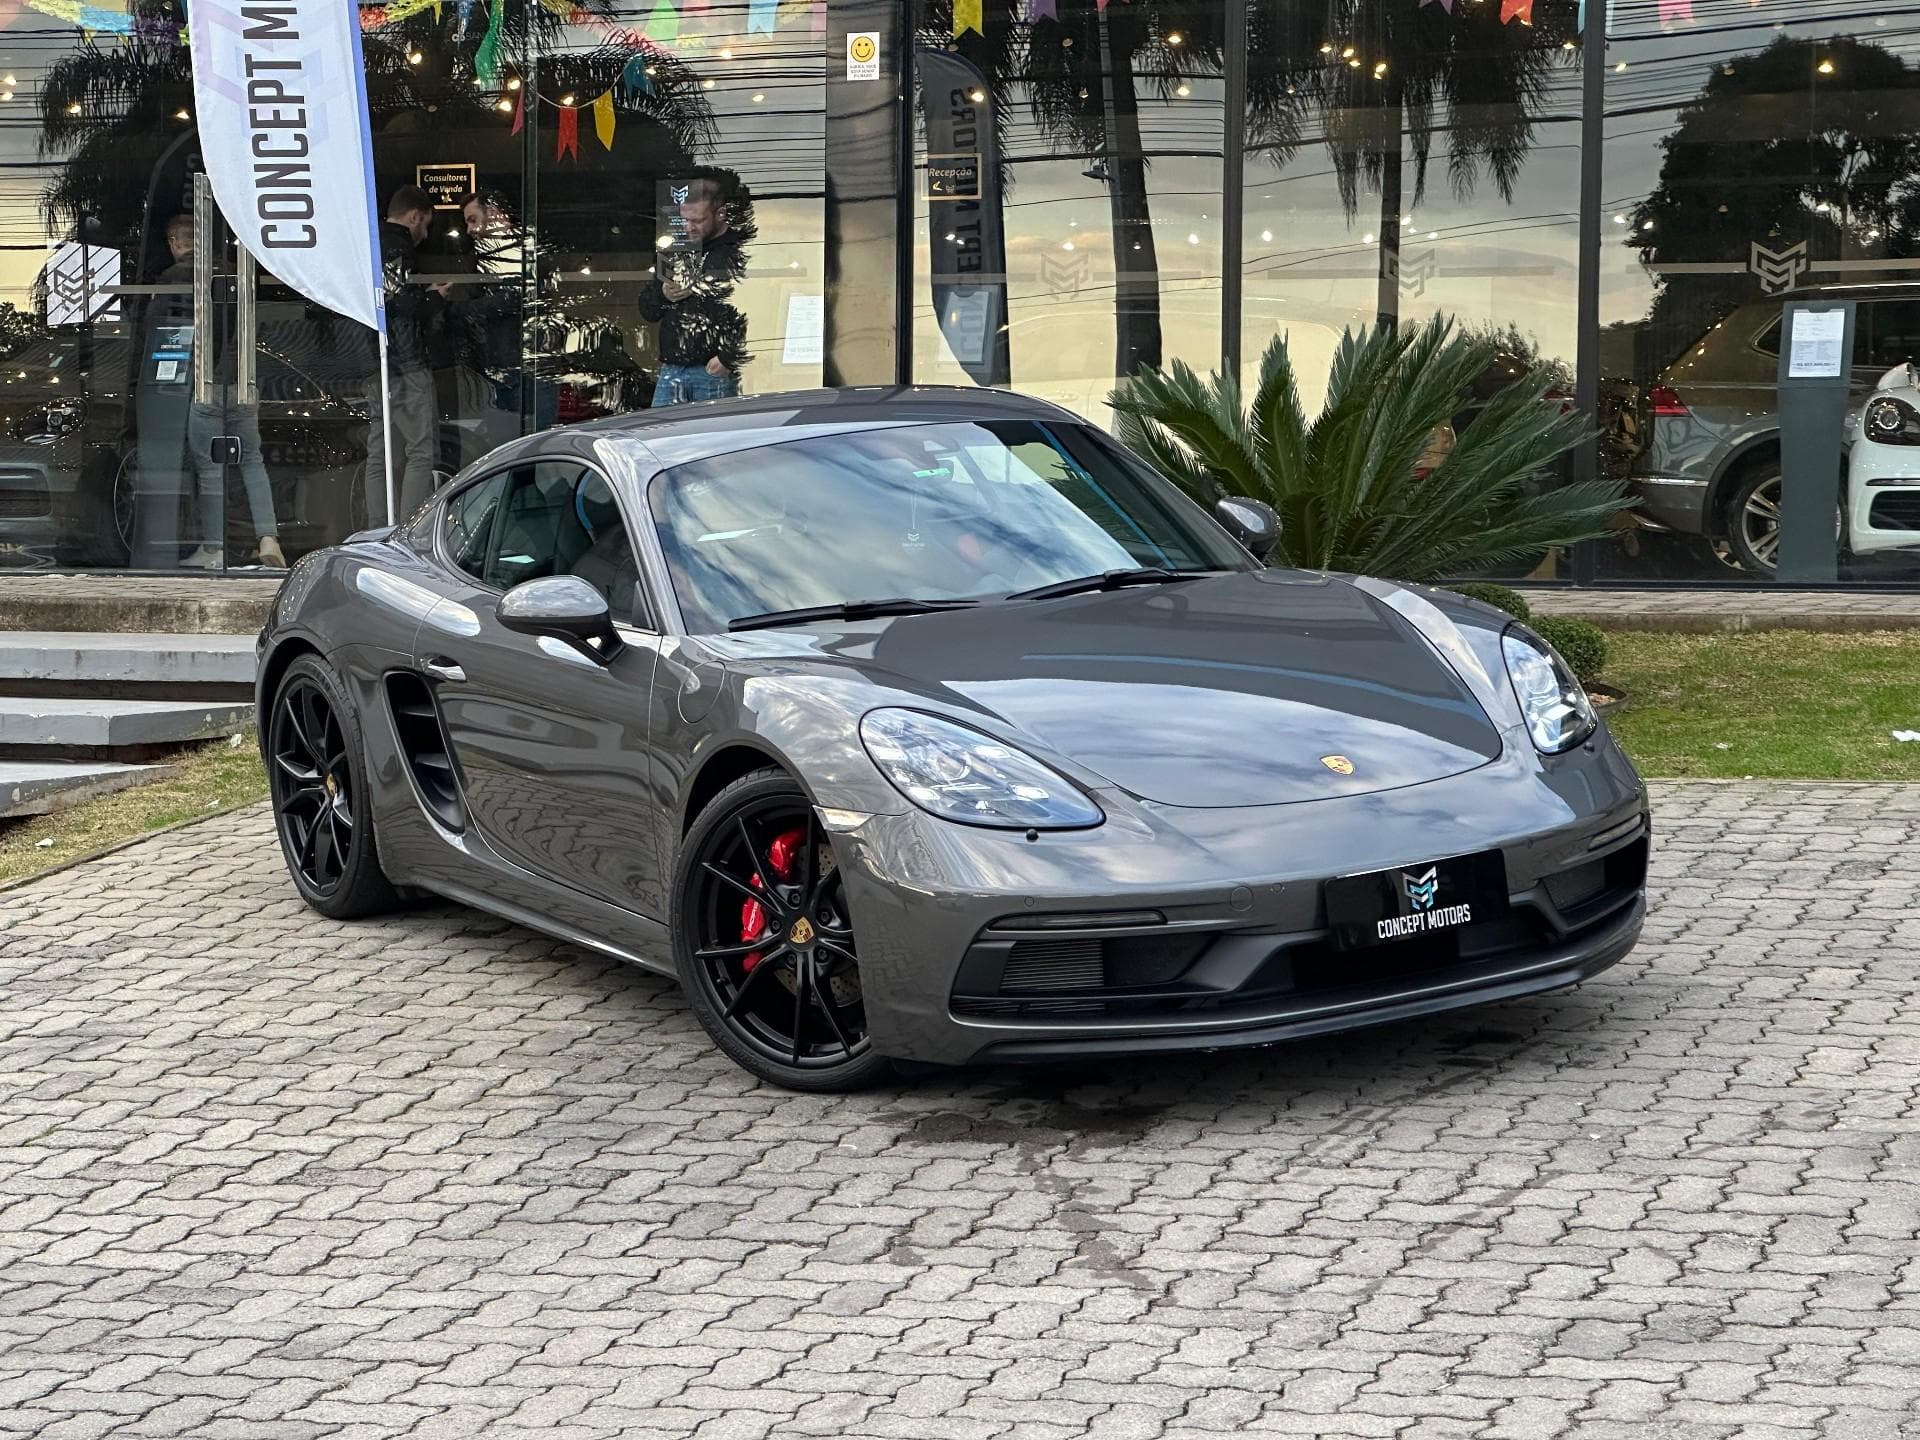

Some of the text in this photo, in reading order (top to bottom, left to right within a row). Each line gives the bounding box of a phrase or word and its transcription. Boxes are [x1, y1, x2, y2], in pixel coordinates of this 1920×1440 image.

[240, 0, 317, 249] CONCEPT M
[424, 173, 468, 182] Consultores
[428, 185, 438, 193] de
[1377, 904, 1471, 939] CONCEPT MOTORS
